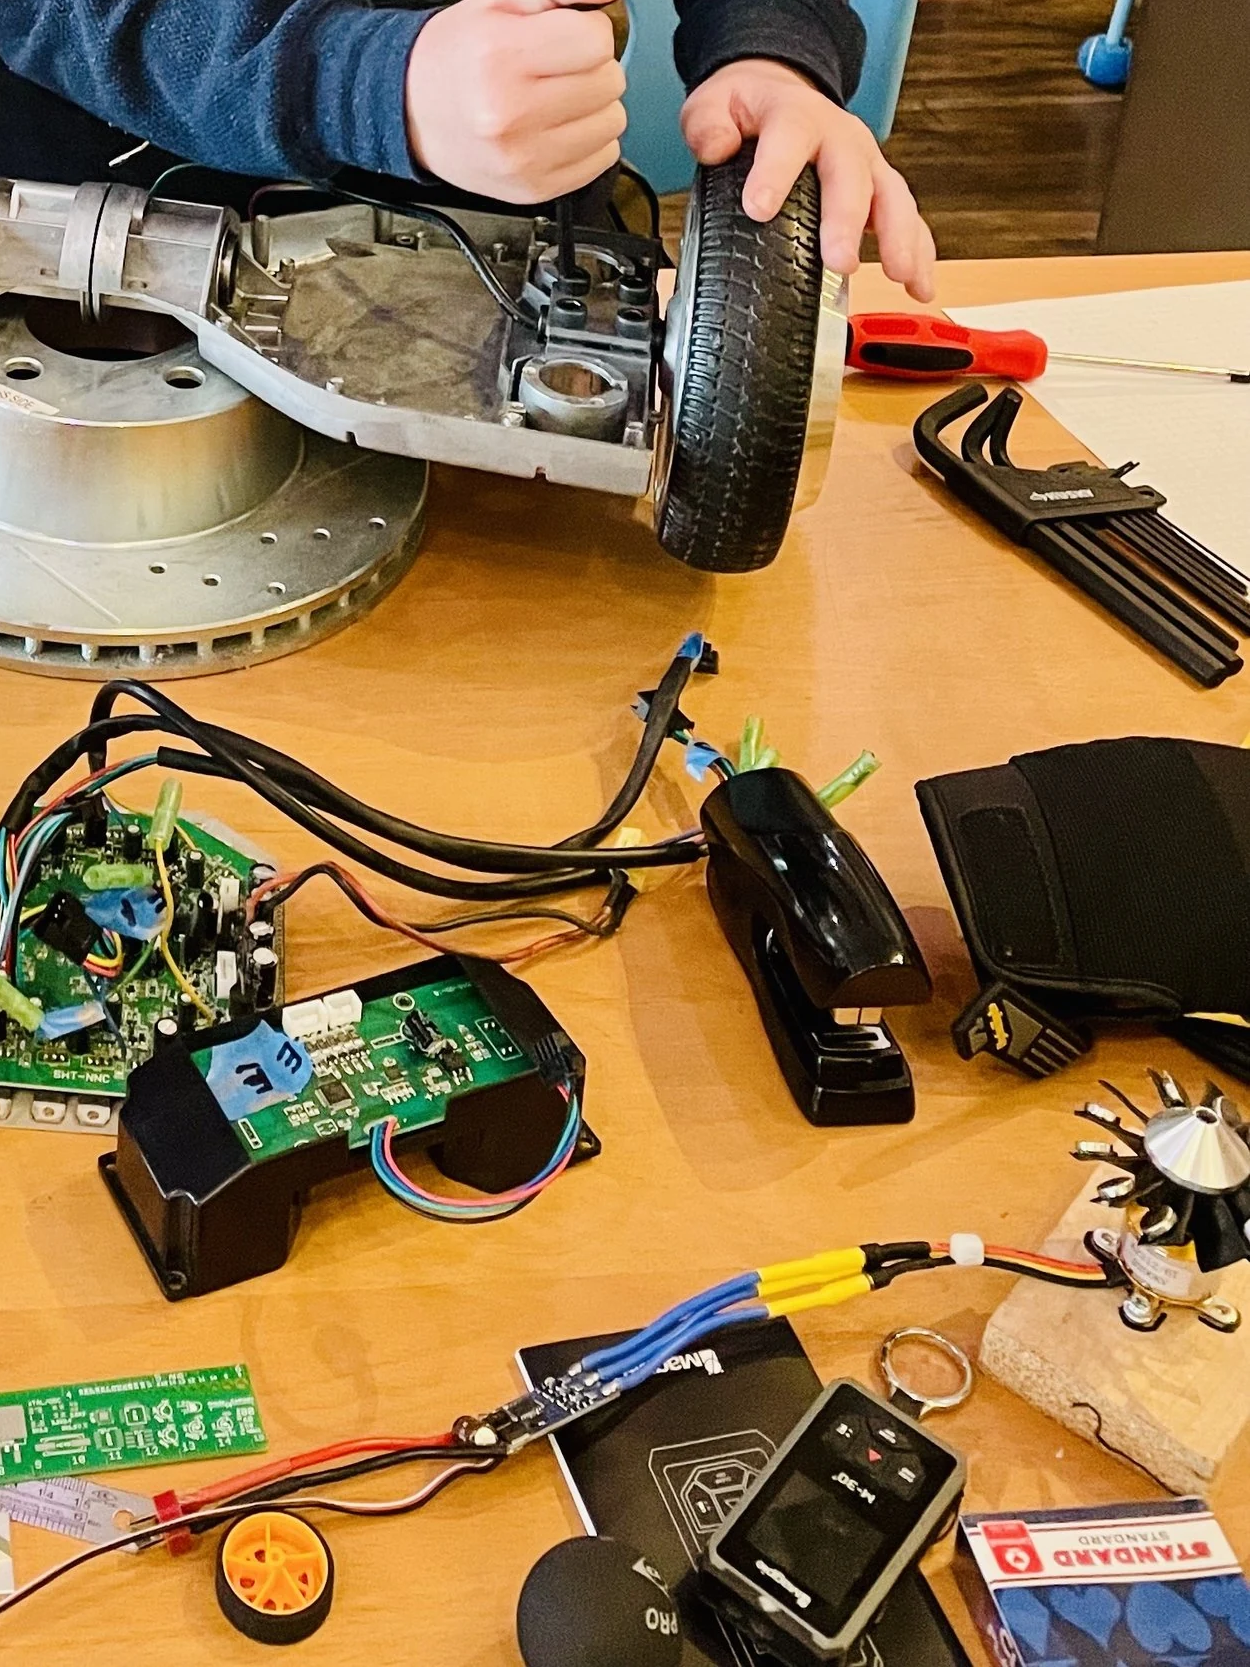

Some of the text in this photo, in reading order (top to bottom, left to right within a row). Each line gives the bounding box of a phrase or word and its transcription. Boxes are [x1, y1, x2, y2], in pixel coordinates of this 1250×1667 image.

[72, 1455, 86, 1465] 10
[109, 1450, 123, 1460] 11
[145, 1445, 159, 1456] 12
[182, 1441, 196, 1452] 13
[1078, 1531, 1170, 1546] STANDARD
[1053, 1541, 1213, 1567] STANDARD
[645, 1607, 678, 1635] PRO
